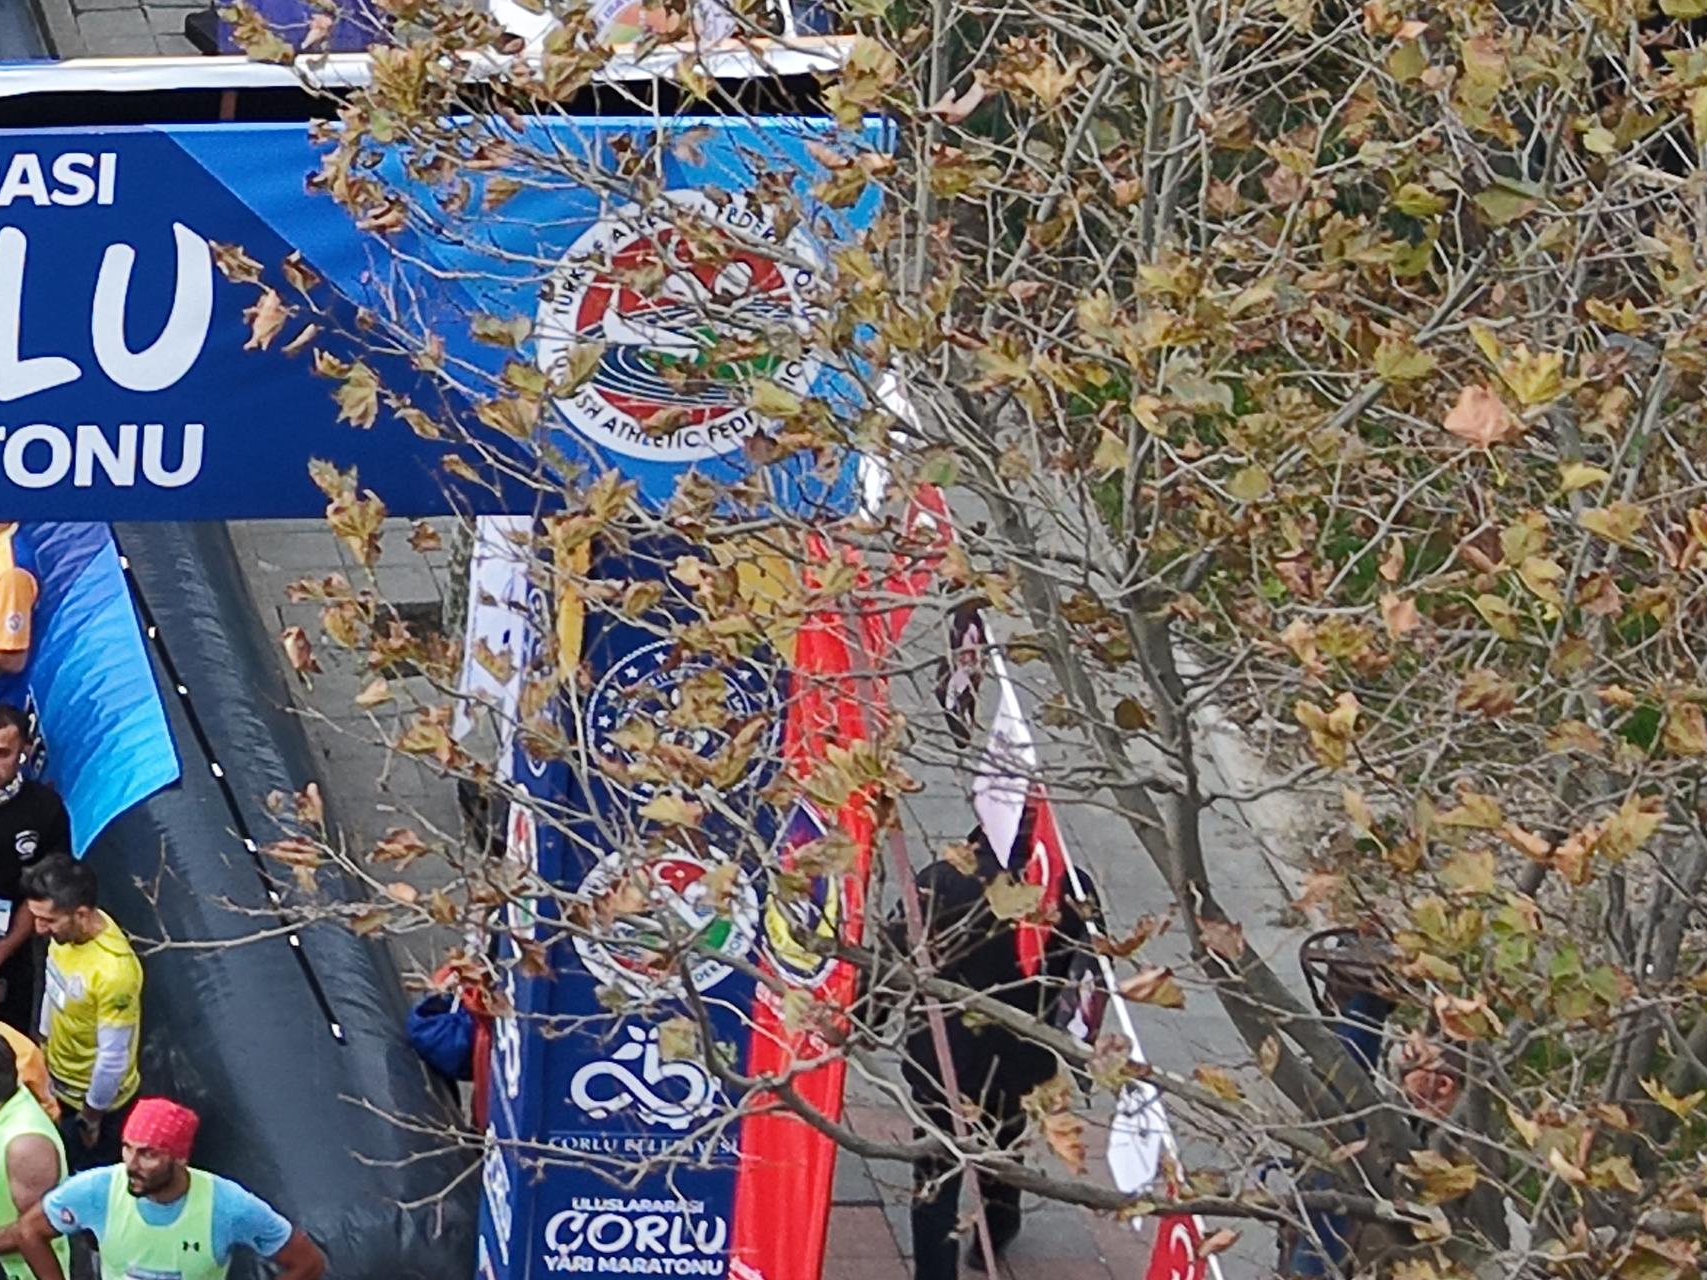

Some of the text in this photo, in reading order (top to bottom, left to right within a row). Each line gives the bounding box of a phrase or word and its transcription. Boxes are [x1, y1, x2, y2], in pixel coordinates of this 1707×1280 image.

[544, 1209, 727, 1257] ÇORLU
[543, 1255, 724, 1276] YARI MARATONU
